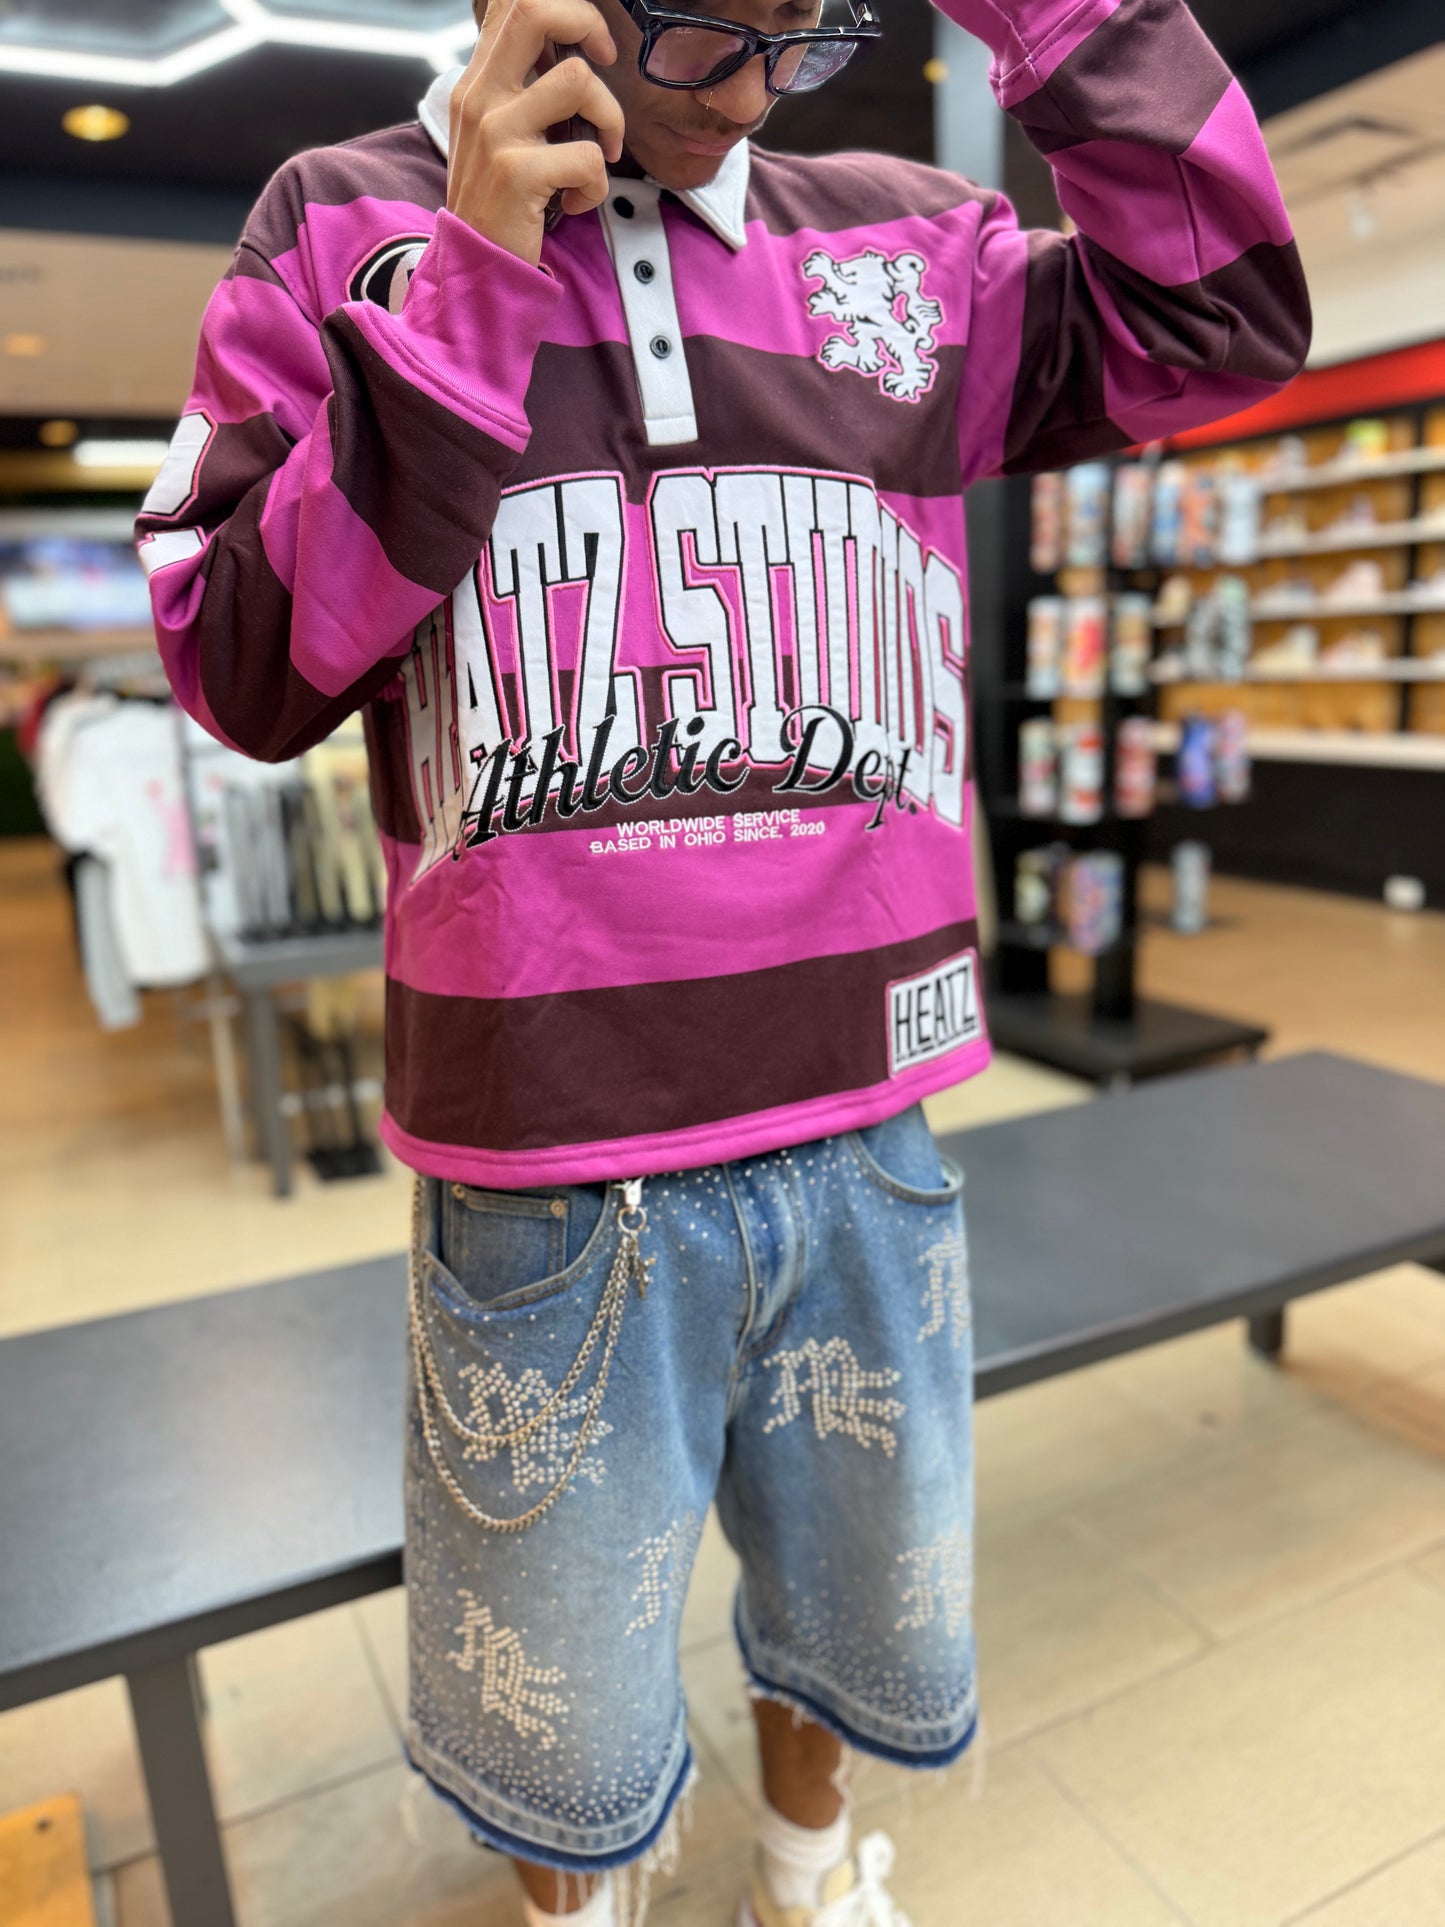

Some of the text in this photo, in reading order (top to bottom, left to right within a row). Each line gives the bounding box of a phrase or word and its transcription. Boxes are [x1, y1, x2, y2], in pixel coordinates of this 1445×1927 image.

[645, 465, 967, 831] STUDIOS
[454, 704, 918, 862] Athletic Dept.
[616, 808, 801, 838] WORLDWIDE SERVICE
[589, 820, 826, 855] BASED IN OHIO SINCE. 2020
[894, 964, 977, 1064] HEATZ
